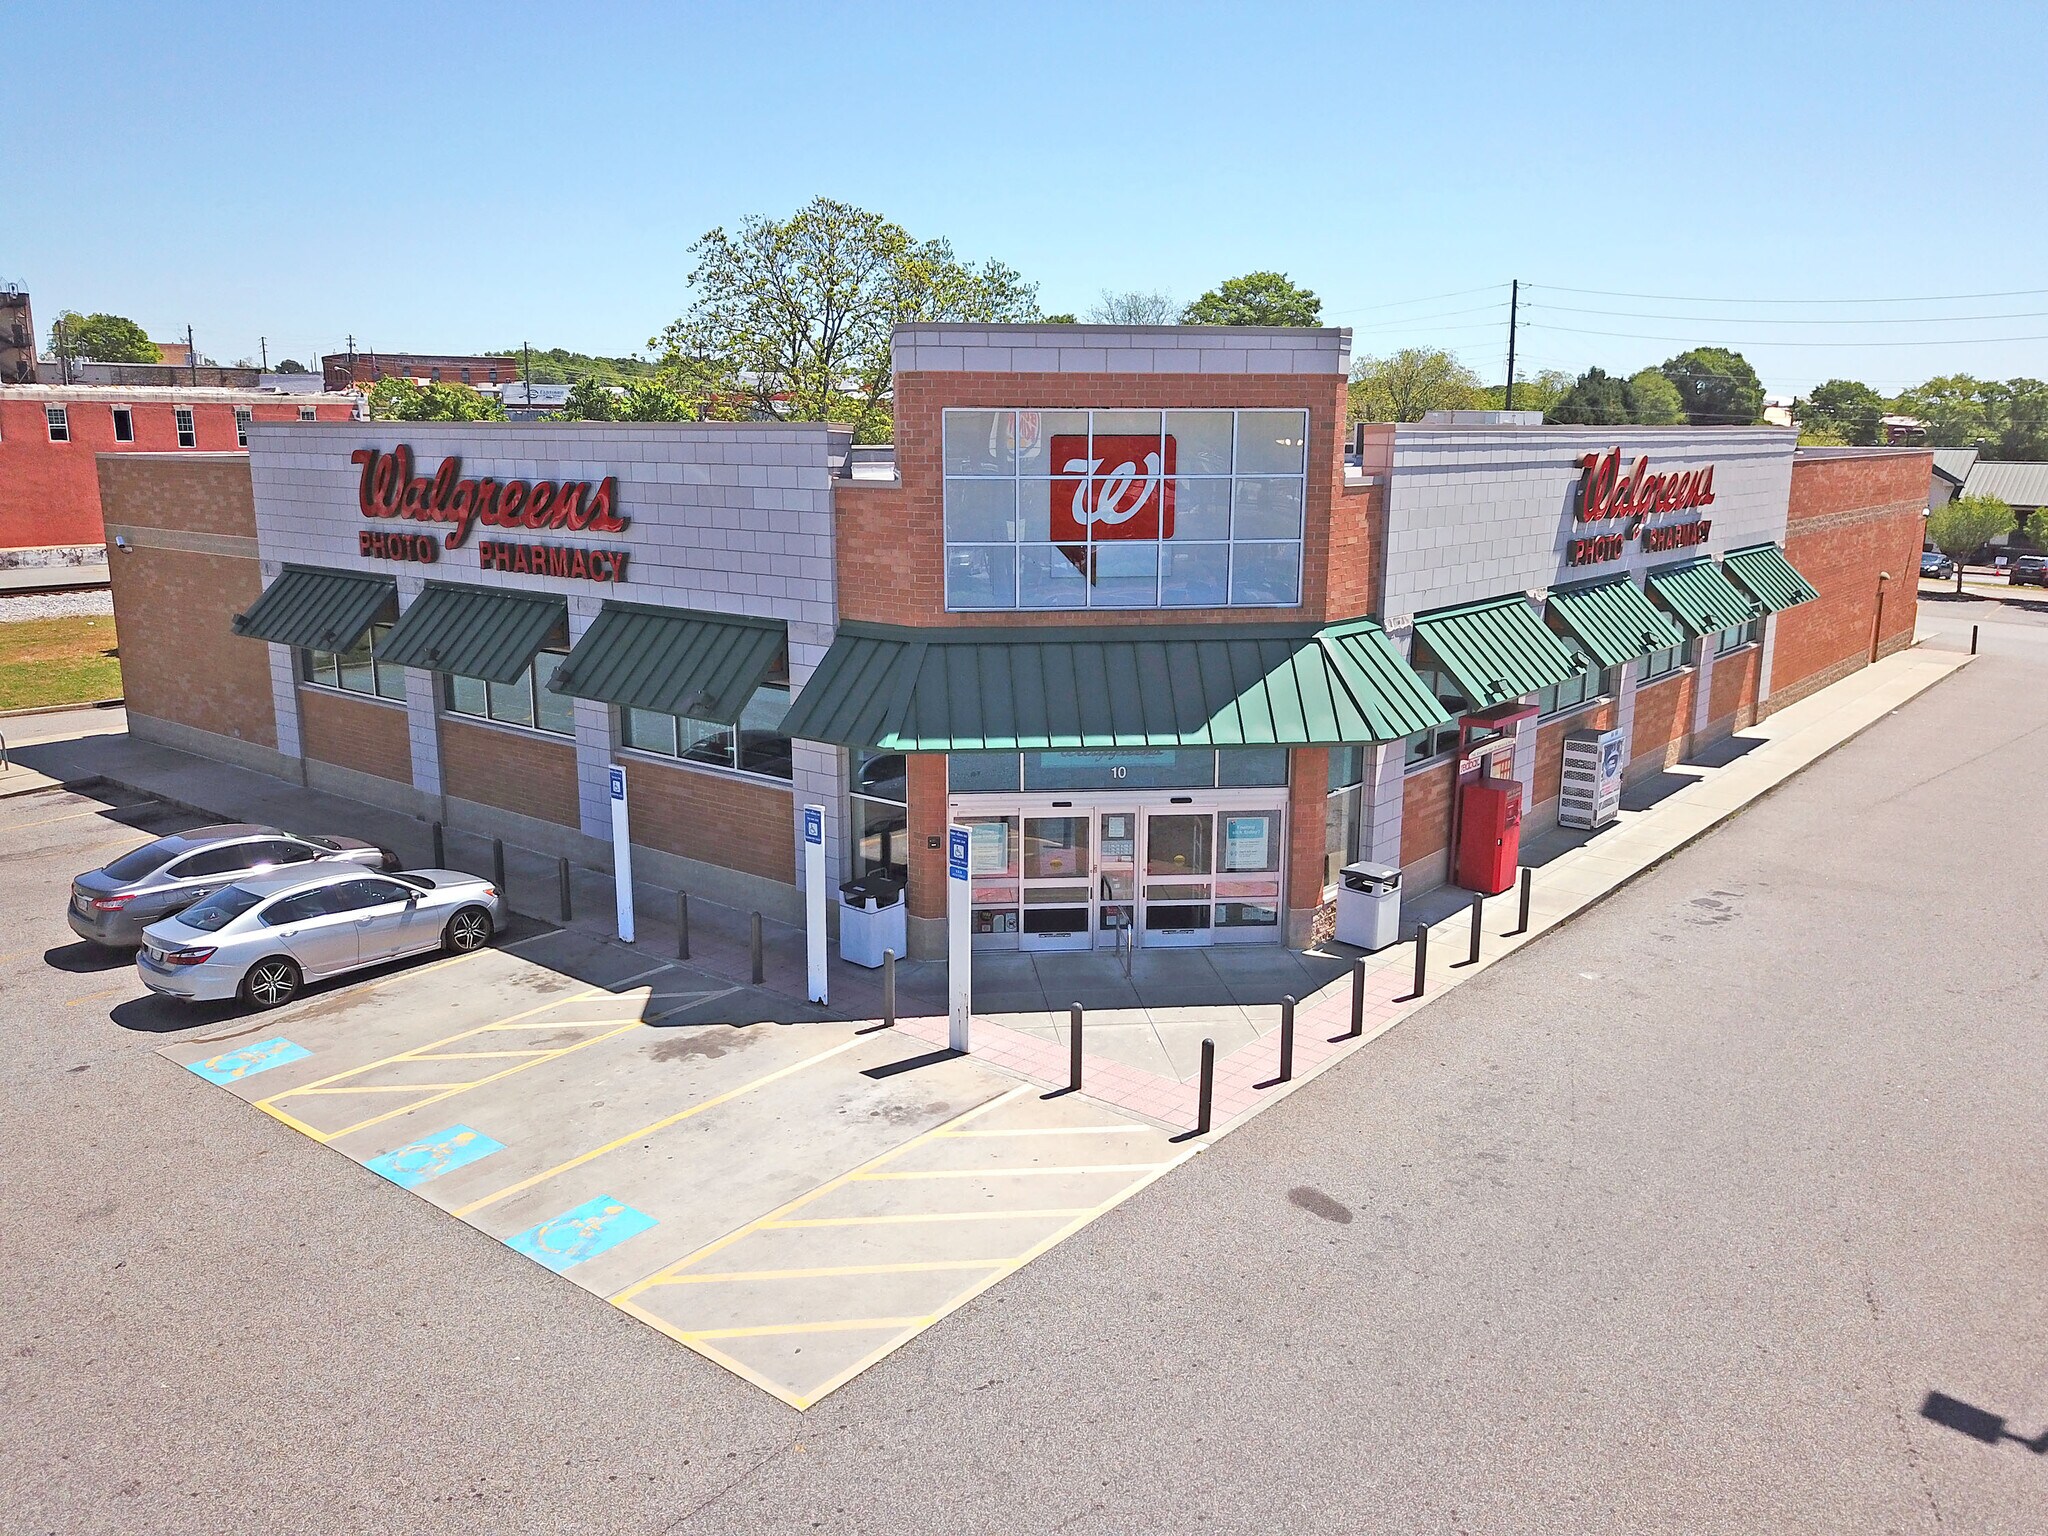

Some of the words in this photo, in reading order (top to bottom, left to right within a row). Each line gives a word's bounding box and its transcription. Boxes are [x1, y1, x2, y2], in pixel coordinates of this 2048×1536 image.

[351, 444, 629, 550] Walgreens
[1575, 445, 1716, 541] Walgreens
[359, 530, 438, 564] PHOTO
[479, 540, 628, 583] PHARMACY
[1572, 532, 1625, 567] PHOTO
[1111, 766, 1127, 779] 10
